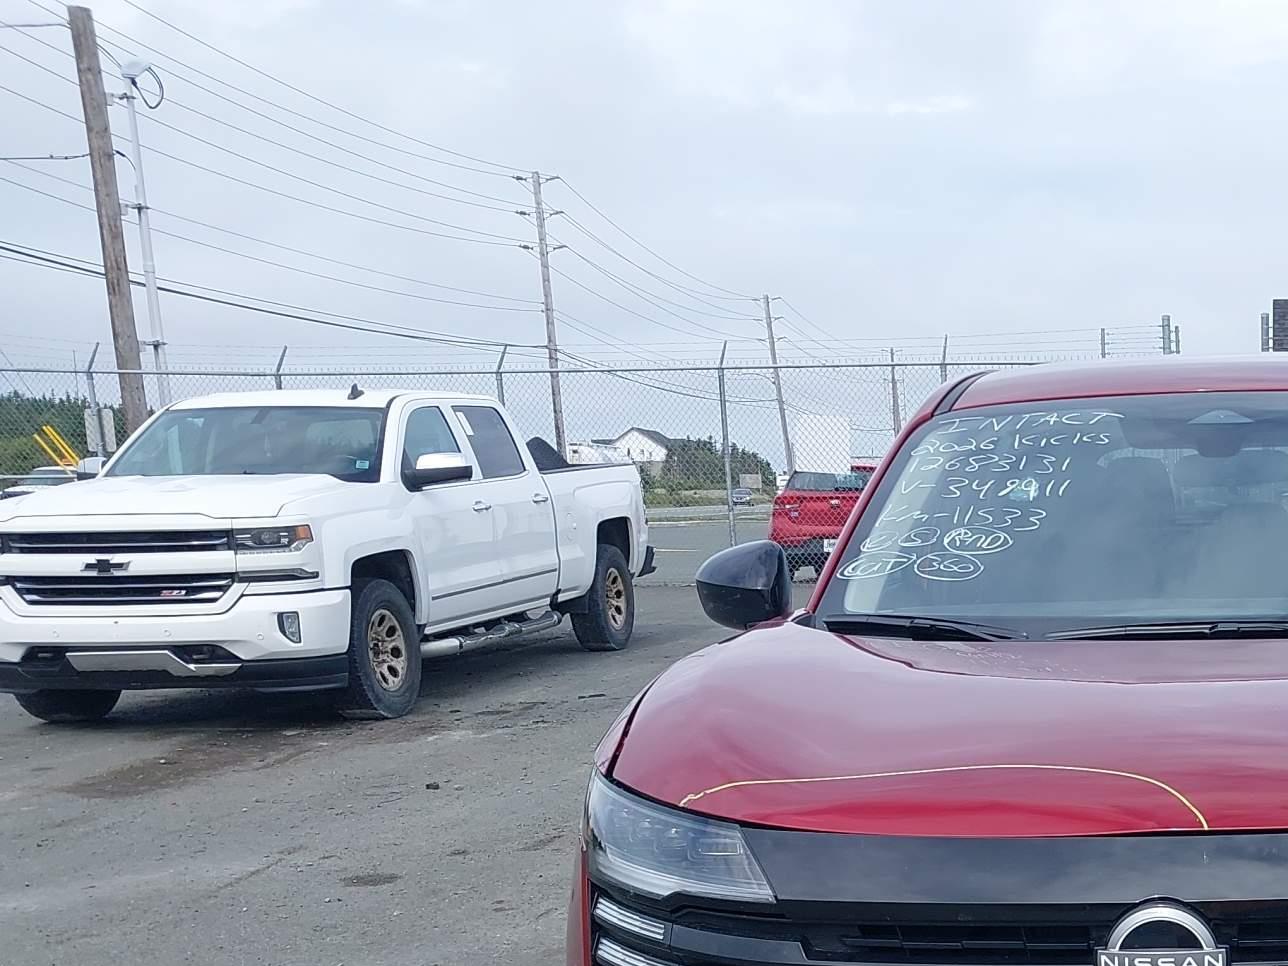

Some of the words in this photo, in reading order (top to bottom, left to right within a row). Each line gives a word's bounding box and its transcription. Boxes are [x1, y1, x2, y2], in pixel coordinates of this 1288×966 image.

[937, 411, 1126, 435] INTACT
[910, 437, 1000, 456] 2026
[909, 453, 1072, 474] 12683131
